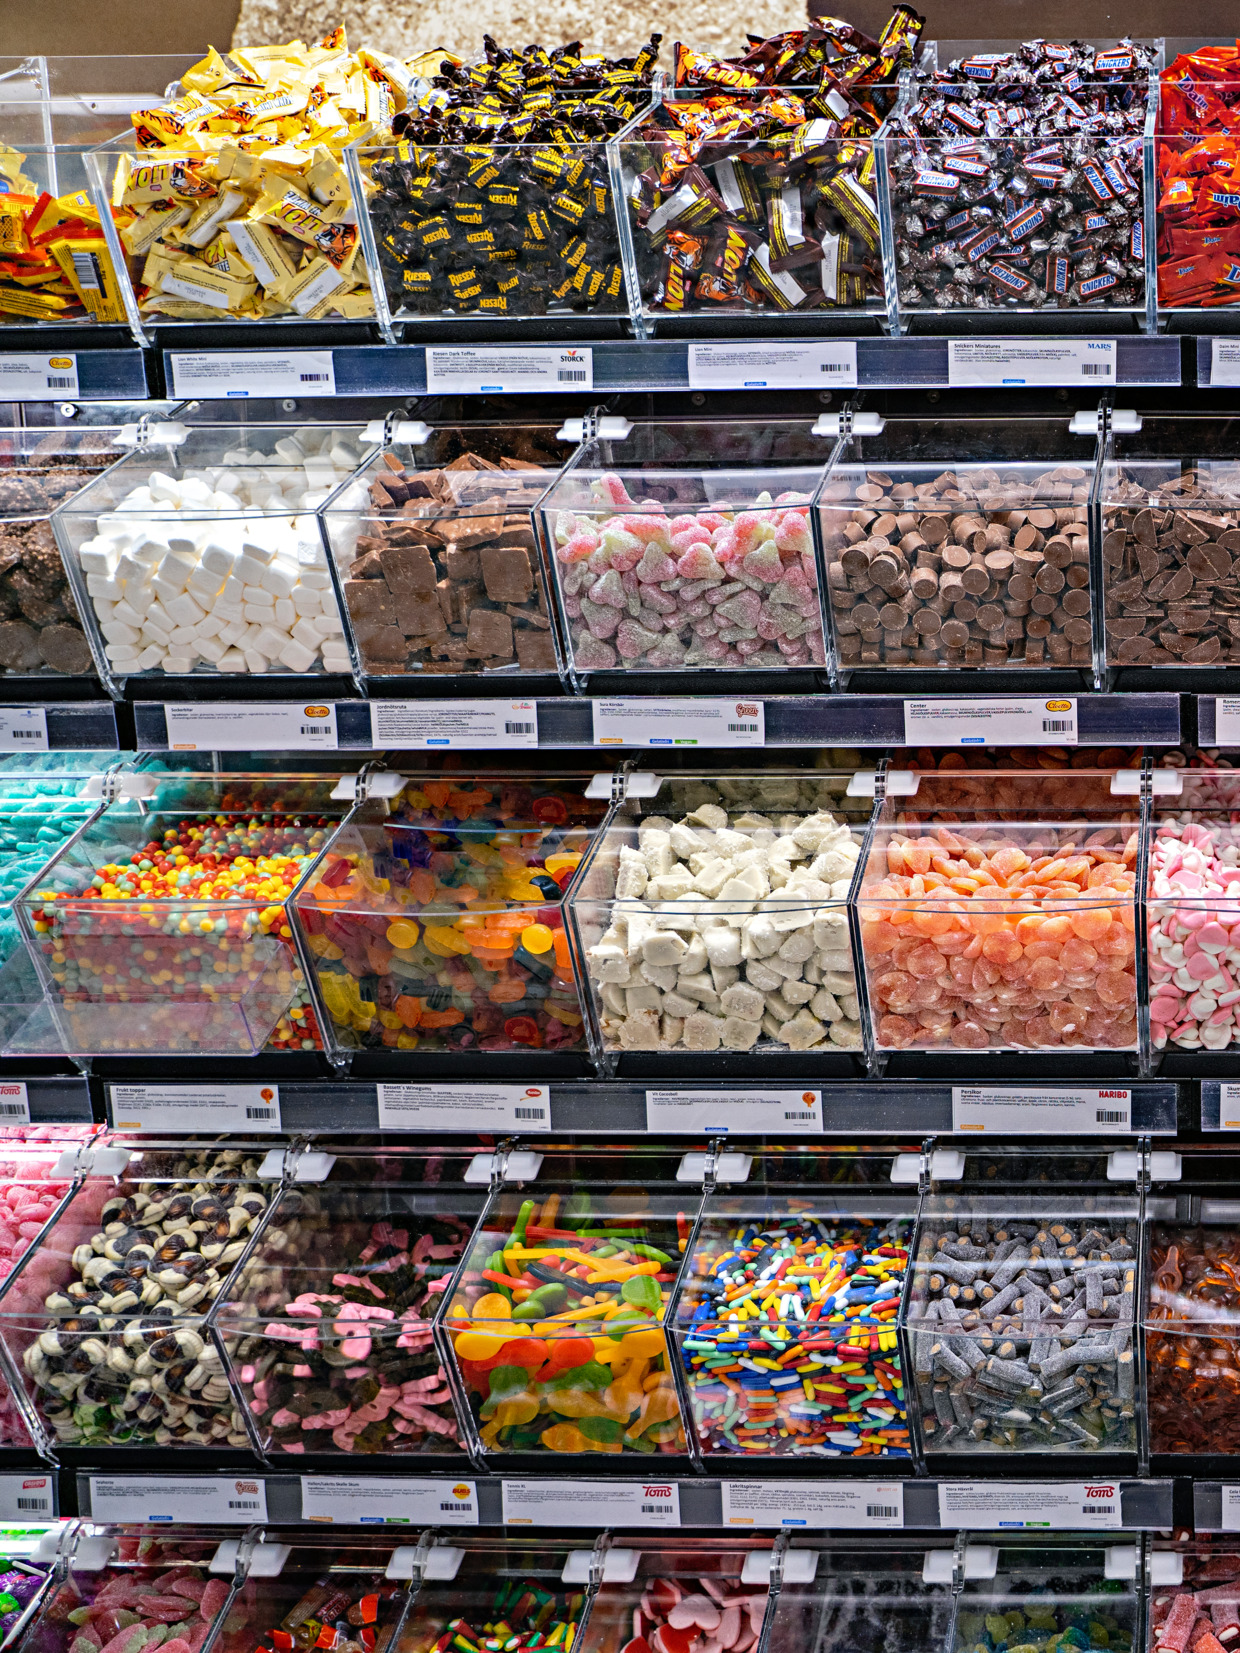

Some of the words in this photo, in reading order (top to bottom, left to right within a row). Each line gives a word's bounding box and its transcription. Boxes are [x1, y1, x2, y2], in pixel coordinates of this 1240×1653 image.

[1096, 56, 1132, 70] SNICKERS
[706, 67, 759, 88] LION
[475, 165, 499, 188] RIESEN
[1083, 166, 1111, 199] SNICKERS
[489, 194, 517, 206] RIESEN
[557, 198, 585, 218] RIESEN
[273, 201, 326, 234] LION
[527, 212, 546, 240] RIESEN
[1012, 211, 1043, 240] SNICKERS
[423, 227, 450, 244] RIESEN
[467, 230, 495, 243] RIESEN
[1132, 221, 1143, 258] SNICKERS
[567, 242, 587, 267] RIESEN
[723, 225, 748, 282] LION
[970, 232, 999, 261] SNICKERS
[404, 270, 431, 281] RIESEN
[448, 270, 476, 285] RIESEN
[498, 276, 519, 293] RIESEN
[607, 265, 622, 296] RIESEN
[991, 266, 1028, 290] SNICKERS
[1056, 259, 1068, 292] SNICKERS
[1080, 274, 1116, 294] SNICKERS
[665, 264, 684, 312] LION
[480, 297, 507, 310] RIESEN
[0, 1086, 22, 1095] Toms
[1099, 1090, 1127, 1098] HARIBO
[643, 1486, 672, 1497] Toms
[1084, 1486, 1115, 1498] Toms
